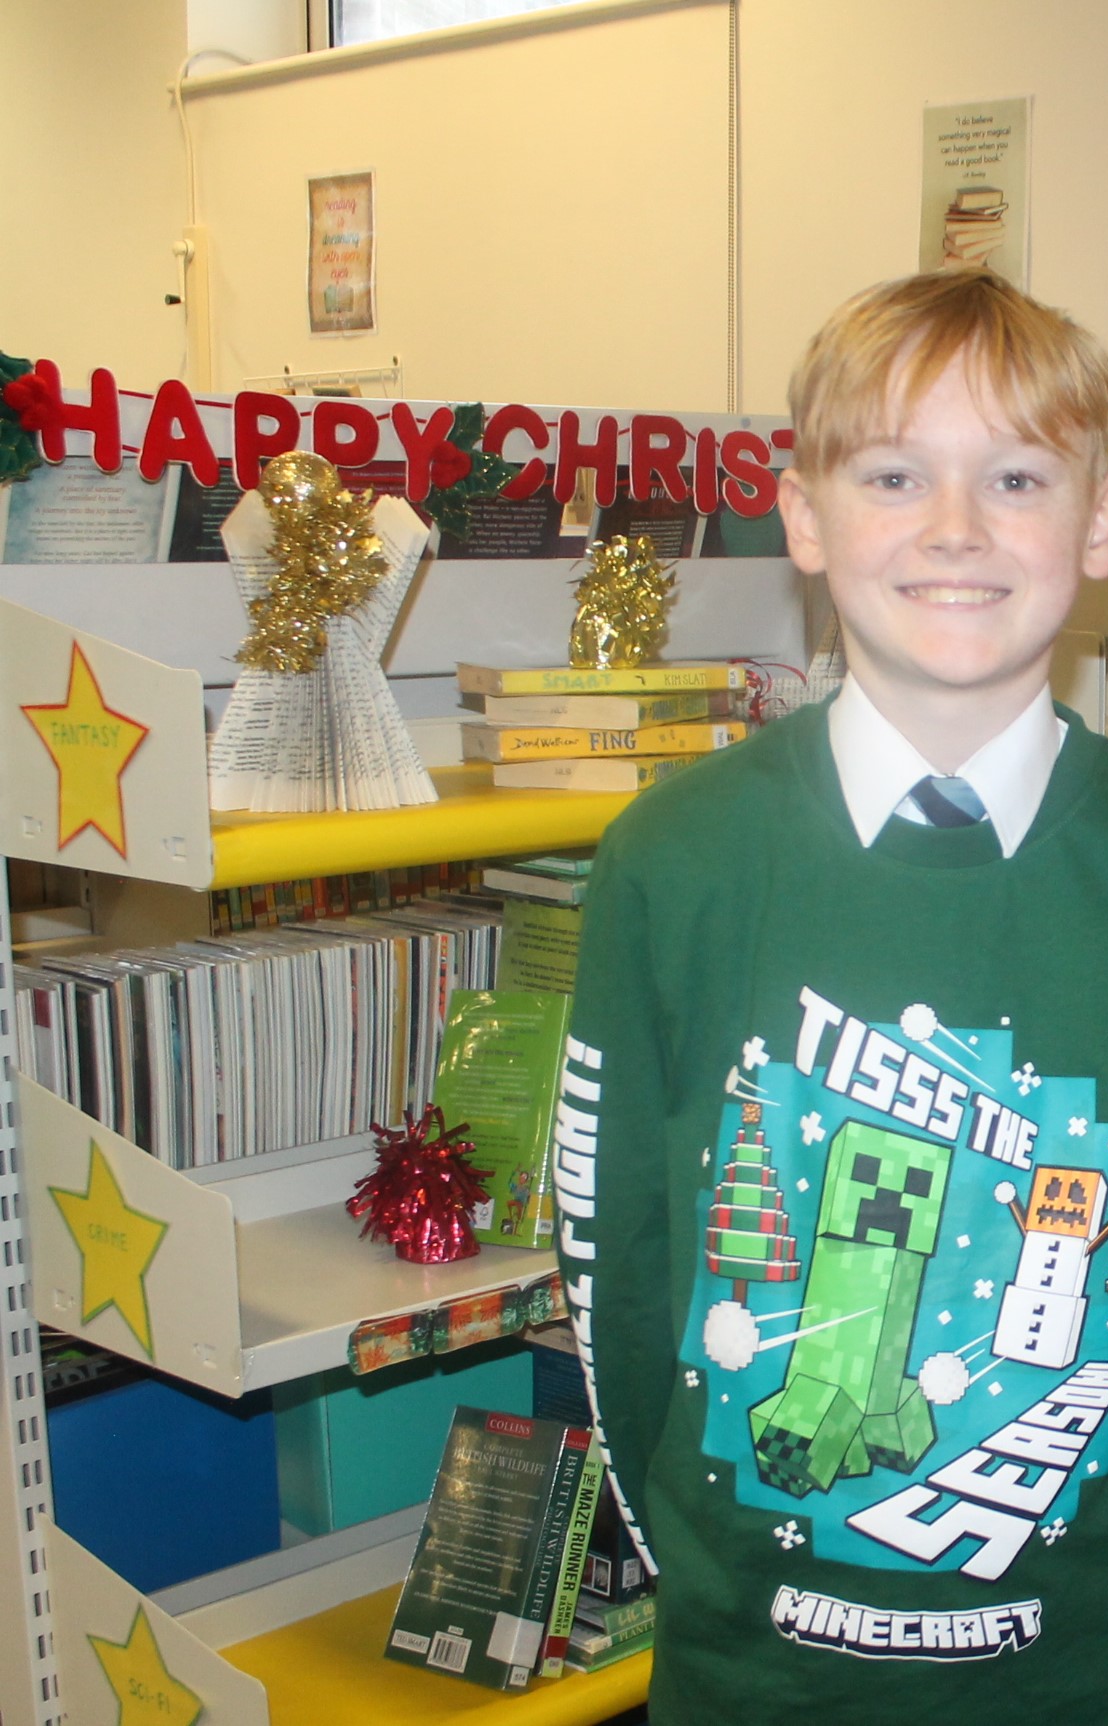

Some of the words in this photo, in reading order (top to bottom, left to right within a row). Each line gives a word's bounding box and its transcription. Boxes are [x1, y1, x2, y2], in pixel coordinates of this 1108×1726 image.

[938, 131, 971, 142] something
[972, 130, 985, 139] very
[987, 126, 1011, 138] magical
[962, 117, 970, 125] do
[972, 115, 993, 125] believe
[941, 145, 951, 154] can
[953, 143, 976, 154] happen
[978, 142, 995, 151] when
[997, 142, 1008, 150] you
[945, 158, 959, 167] read
[965, 155, 982, 167] good
[34, 358, 457, 502] HAPPY
[542, 672, 613, 690] SMART
[664, 673, 682, 686] KIM
[51, 722, 121, 748] FANTASY
[589, 731, 637, 751] FING
[794, 984, 969, 1142] TISSS
[967, 1091, 1040, 1171] THE
[552, 1032, 602, 1260] FIGHT!
[88, 1223, 128, 1251] CRIME
[489, 1419, 531, 1435] COLLINS
[582, 1473, 597, 1487] THE
[551, 1455, 578, 1535] BRITISH
[574, 1488, 595, 1529] MAZE
[562, 1532, 586, 1592] RUNNER
[530, 1534, 559, 1620] WILDLIFE
[554, 1595, 567, 1634] DASHNER
[562, 1601, 573, 1629] JAMES
[772, 1585, 1042, 1661] MINECRAFT
[129, 1678, 171, 1714] SCI-FI
